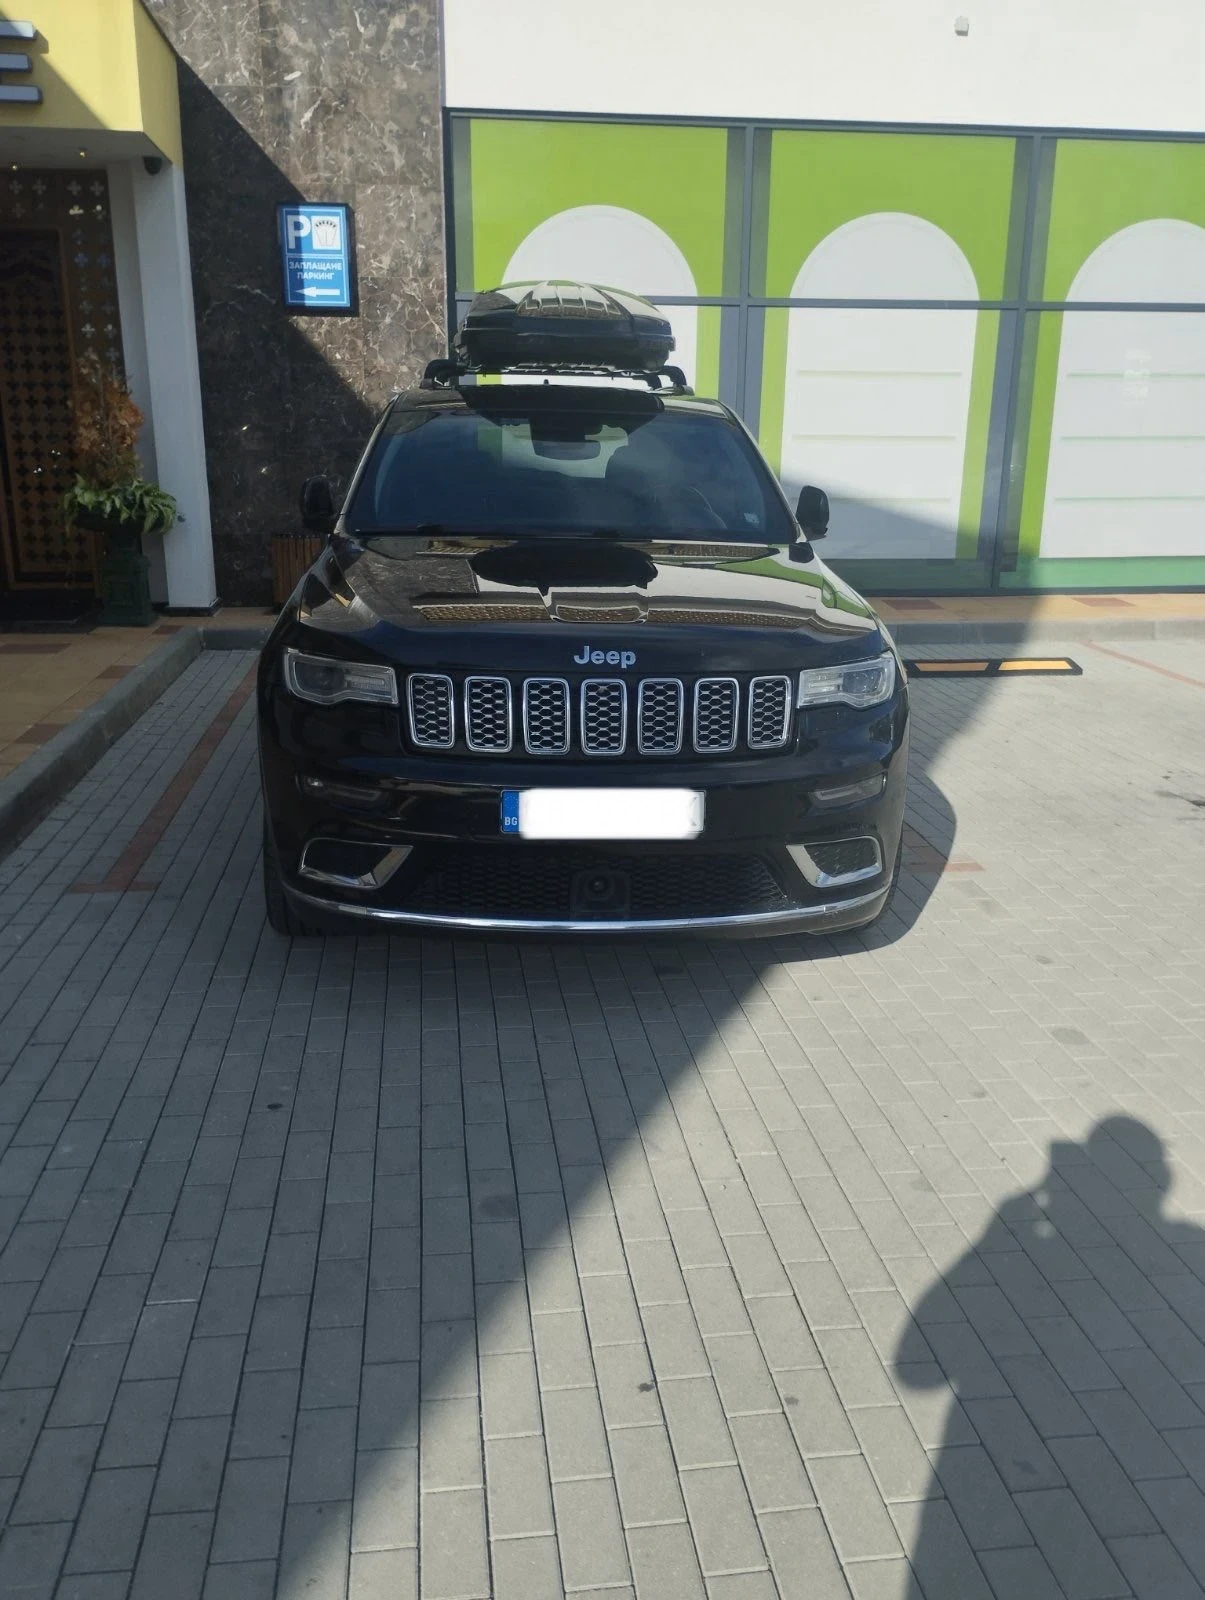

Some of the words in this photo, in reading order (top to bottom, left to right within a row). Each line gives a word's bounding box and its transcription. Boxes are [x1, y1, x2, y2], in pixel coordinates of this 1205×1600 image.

[287, 215, 311, 249] P
[289, 261, 343, 271] ЗАПЛАЩАНЕ
[297, 271, 335, 280] ПАРКИНГ
[573, 645, 636, 669] Jeep
[504, 816, 518, 826] BG
